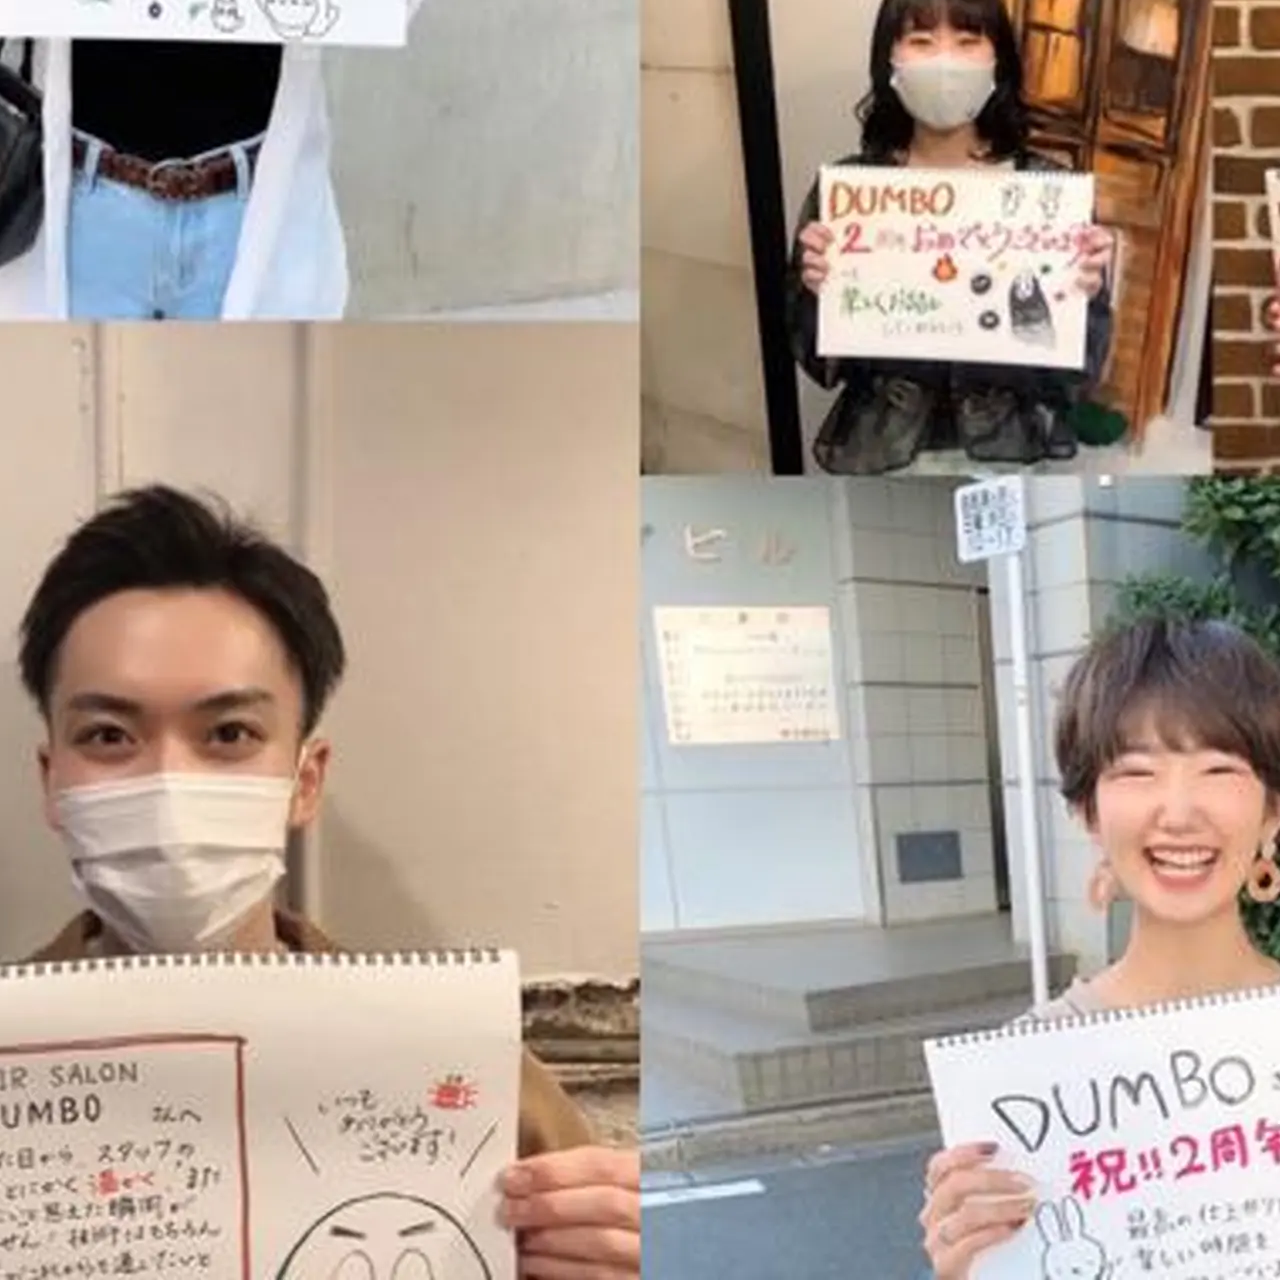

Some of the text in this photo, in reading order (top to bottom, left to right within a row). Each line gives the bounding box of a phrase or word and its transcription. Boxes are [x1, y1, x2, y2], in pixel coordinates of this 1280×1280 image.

[829, 181, 955, 220] DUMBO
[49, 1060, 140, 1091] SALON
[992, 1049, 1256, 1153] DUMBO
